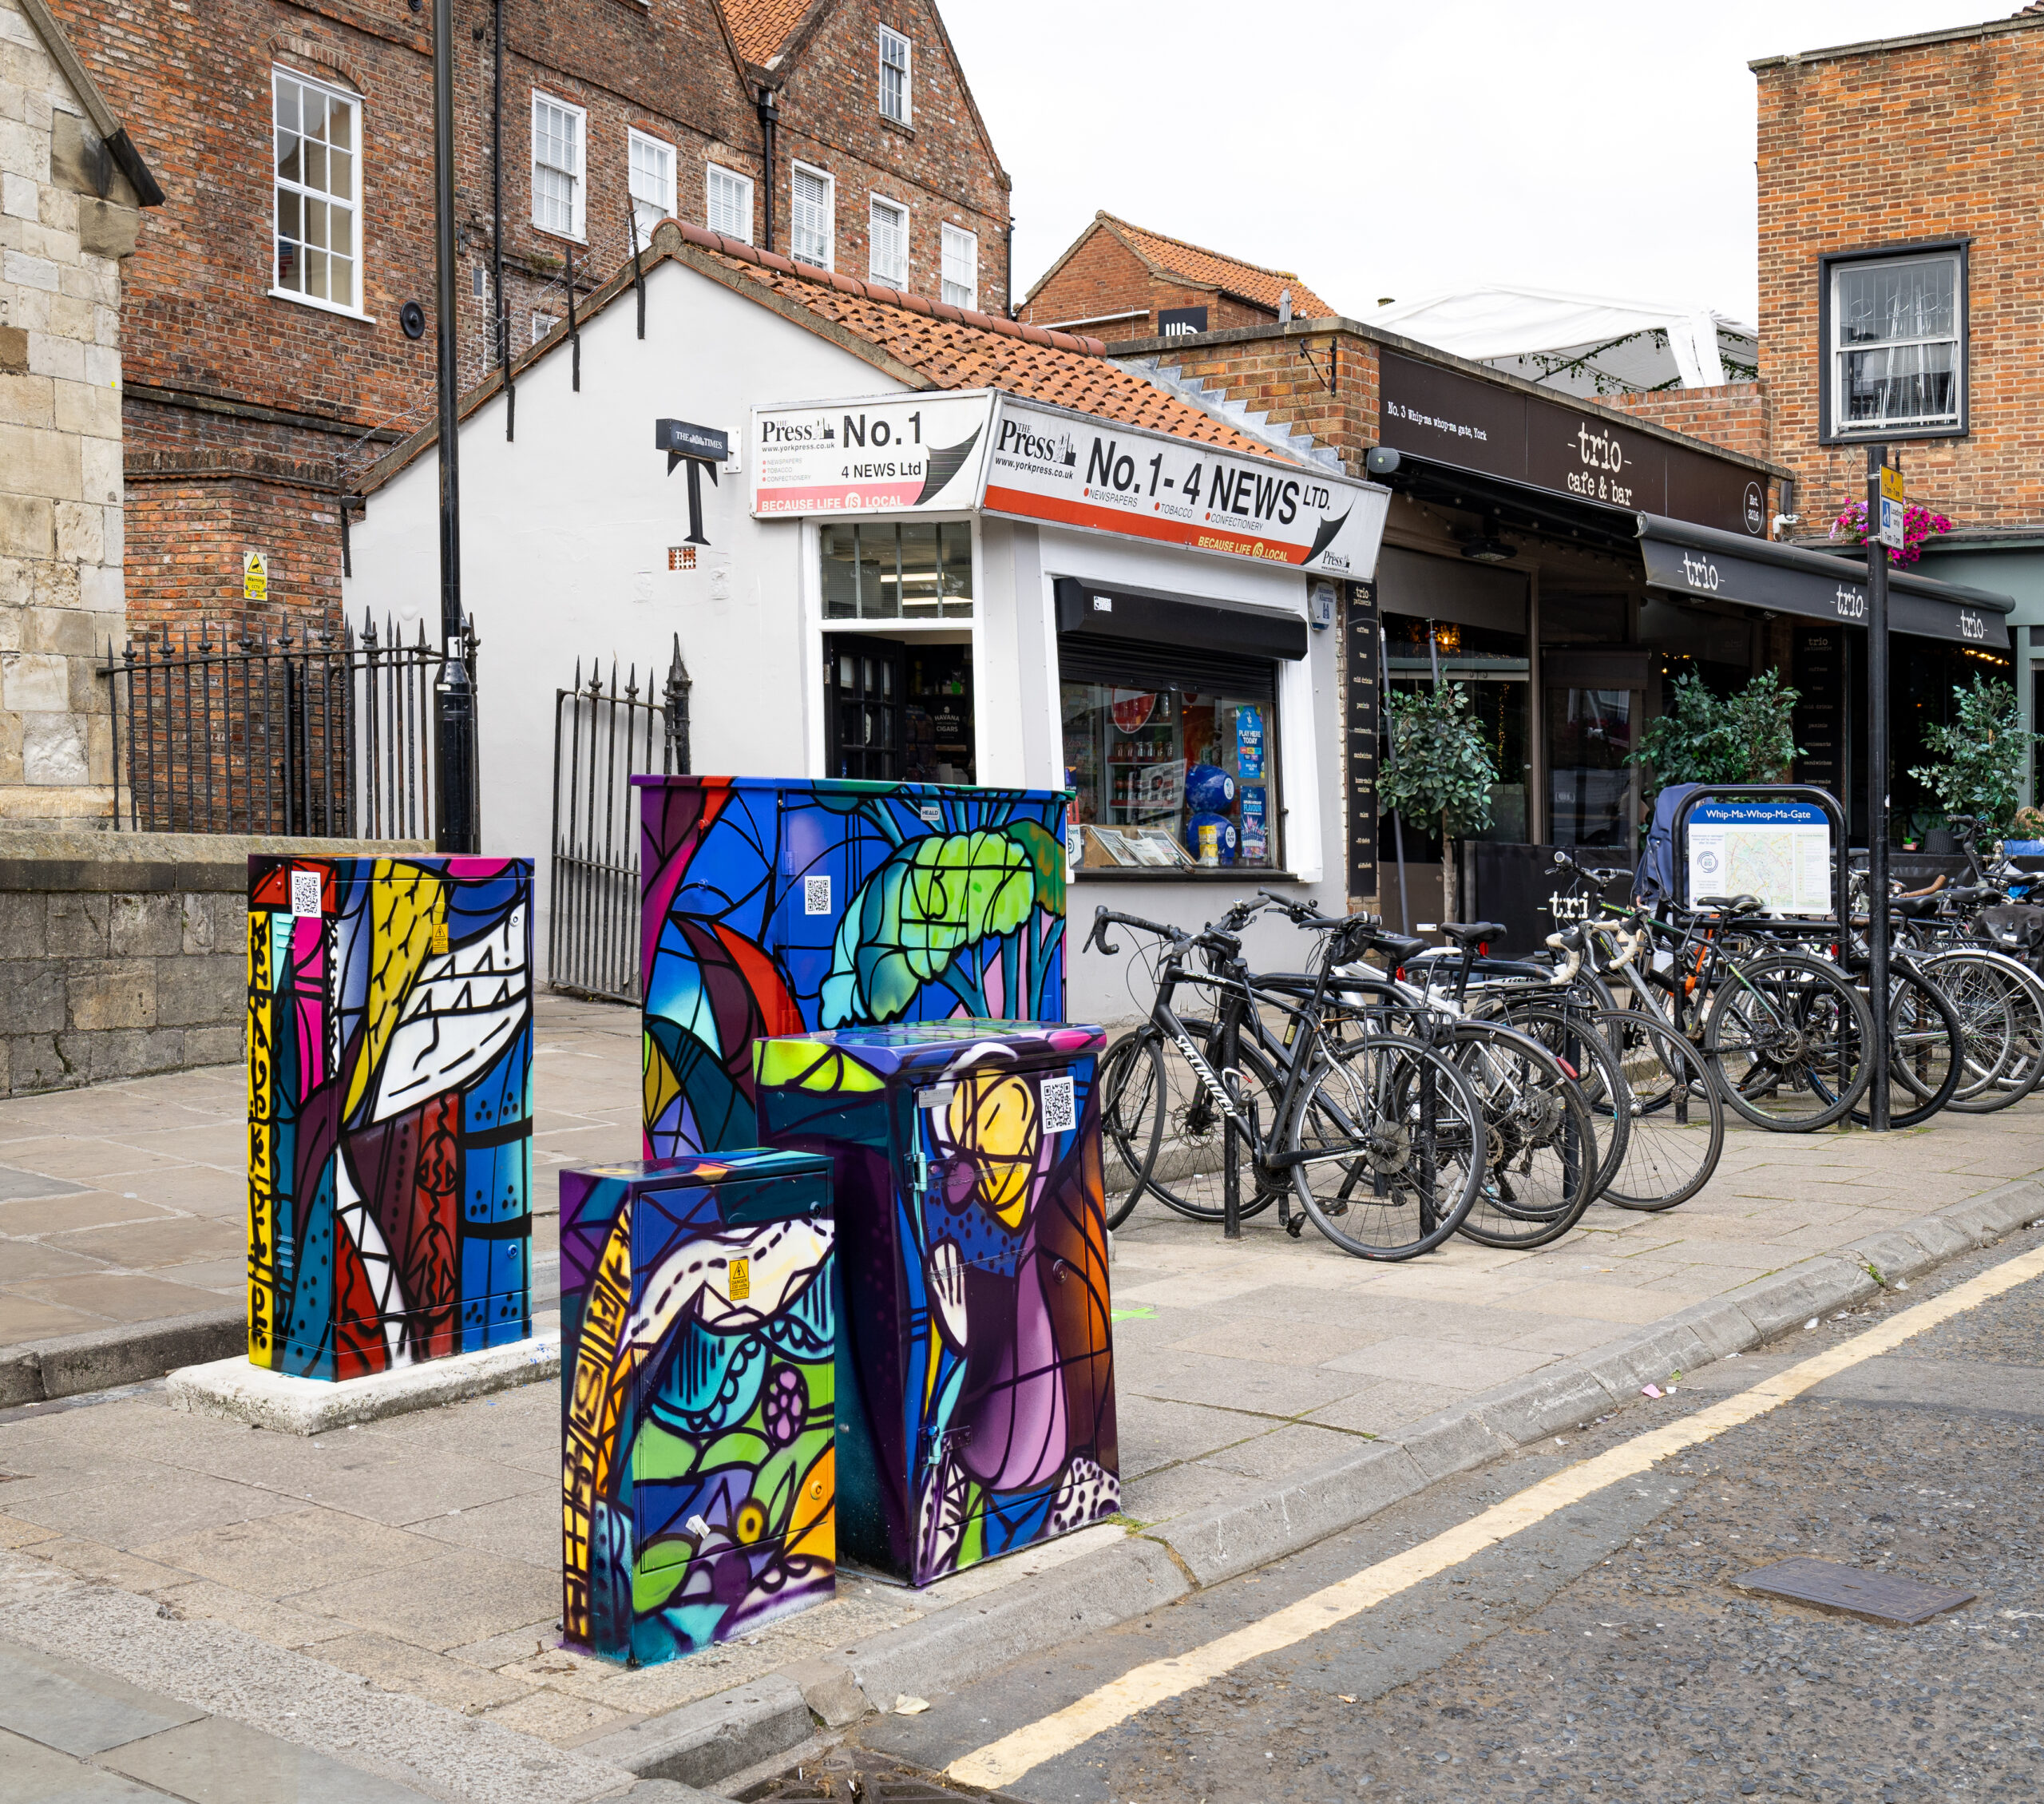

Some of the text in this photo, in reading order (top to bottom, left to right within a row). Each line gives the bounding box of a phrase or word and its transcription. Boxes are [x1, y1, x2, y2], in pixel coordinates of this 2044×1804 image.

[843, 411, 921, 448] No.1
[1017, 422, 1032, 434] THE
[1388, 401, 1487, 441] No. 3 Whip-ma whop-ma gate, York
[675, 430, 723, 450] THE TIMES
[762, 421, 813, 442] Press
[996, 418, 1056, 462] Press
[762, 442, 835, 453] www.yorkpress.co.uk
[841, 461, 922, 479] 4 NEWS Ltd
[995, 457, 1073, 480] www.yorkpress.co.uk
[1208, 465, 1300, 525] NEWS
[1303, 484, 1331, 510] LTD.
[1567, 470, 1632, 506] cafe & bar
[762, 497, 814, 512] BECAUSE
[817, 496, 842, 510] LIFE
[866, 494, 905, 508] LOCAL
[1088, 489, 1139, 508] NEWSPAPERS
[1161, 503, 1193, 518] TOBACCO
[1891, 506, 1903, 519] Loading
[1210, 513, 1264, 531] CONFECTIONERY
[1198, 536, 1234, 553] BECAUSE
[1234, 541, 1252, 556] LIFE
[1265, 548, 1288, 561] LOCAL
[1322, 551, 1343, 566] Press
[454, 638, 461, 656] 1
[1243, 803, 1262, 812] FLAVOUR
[1705, 809, 1811, 821] Whip-Ma-Whop-Ma-Gate
[1175, 1034, 1238, 1116] SPECIALIZED
